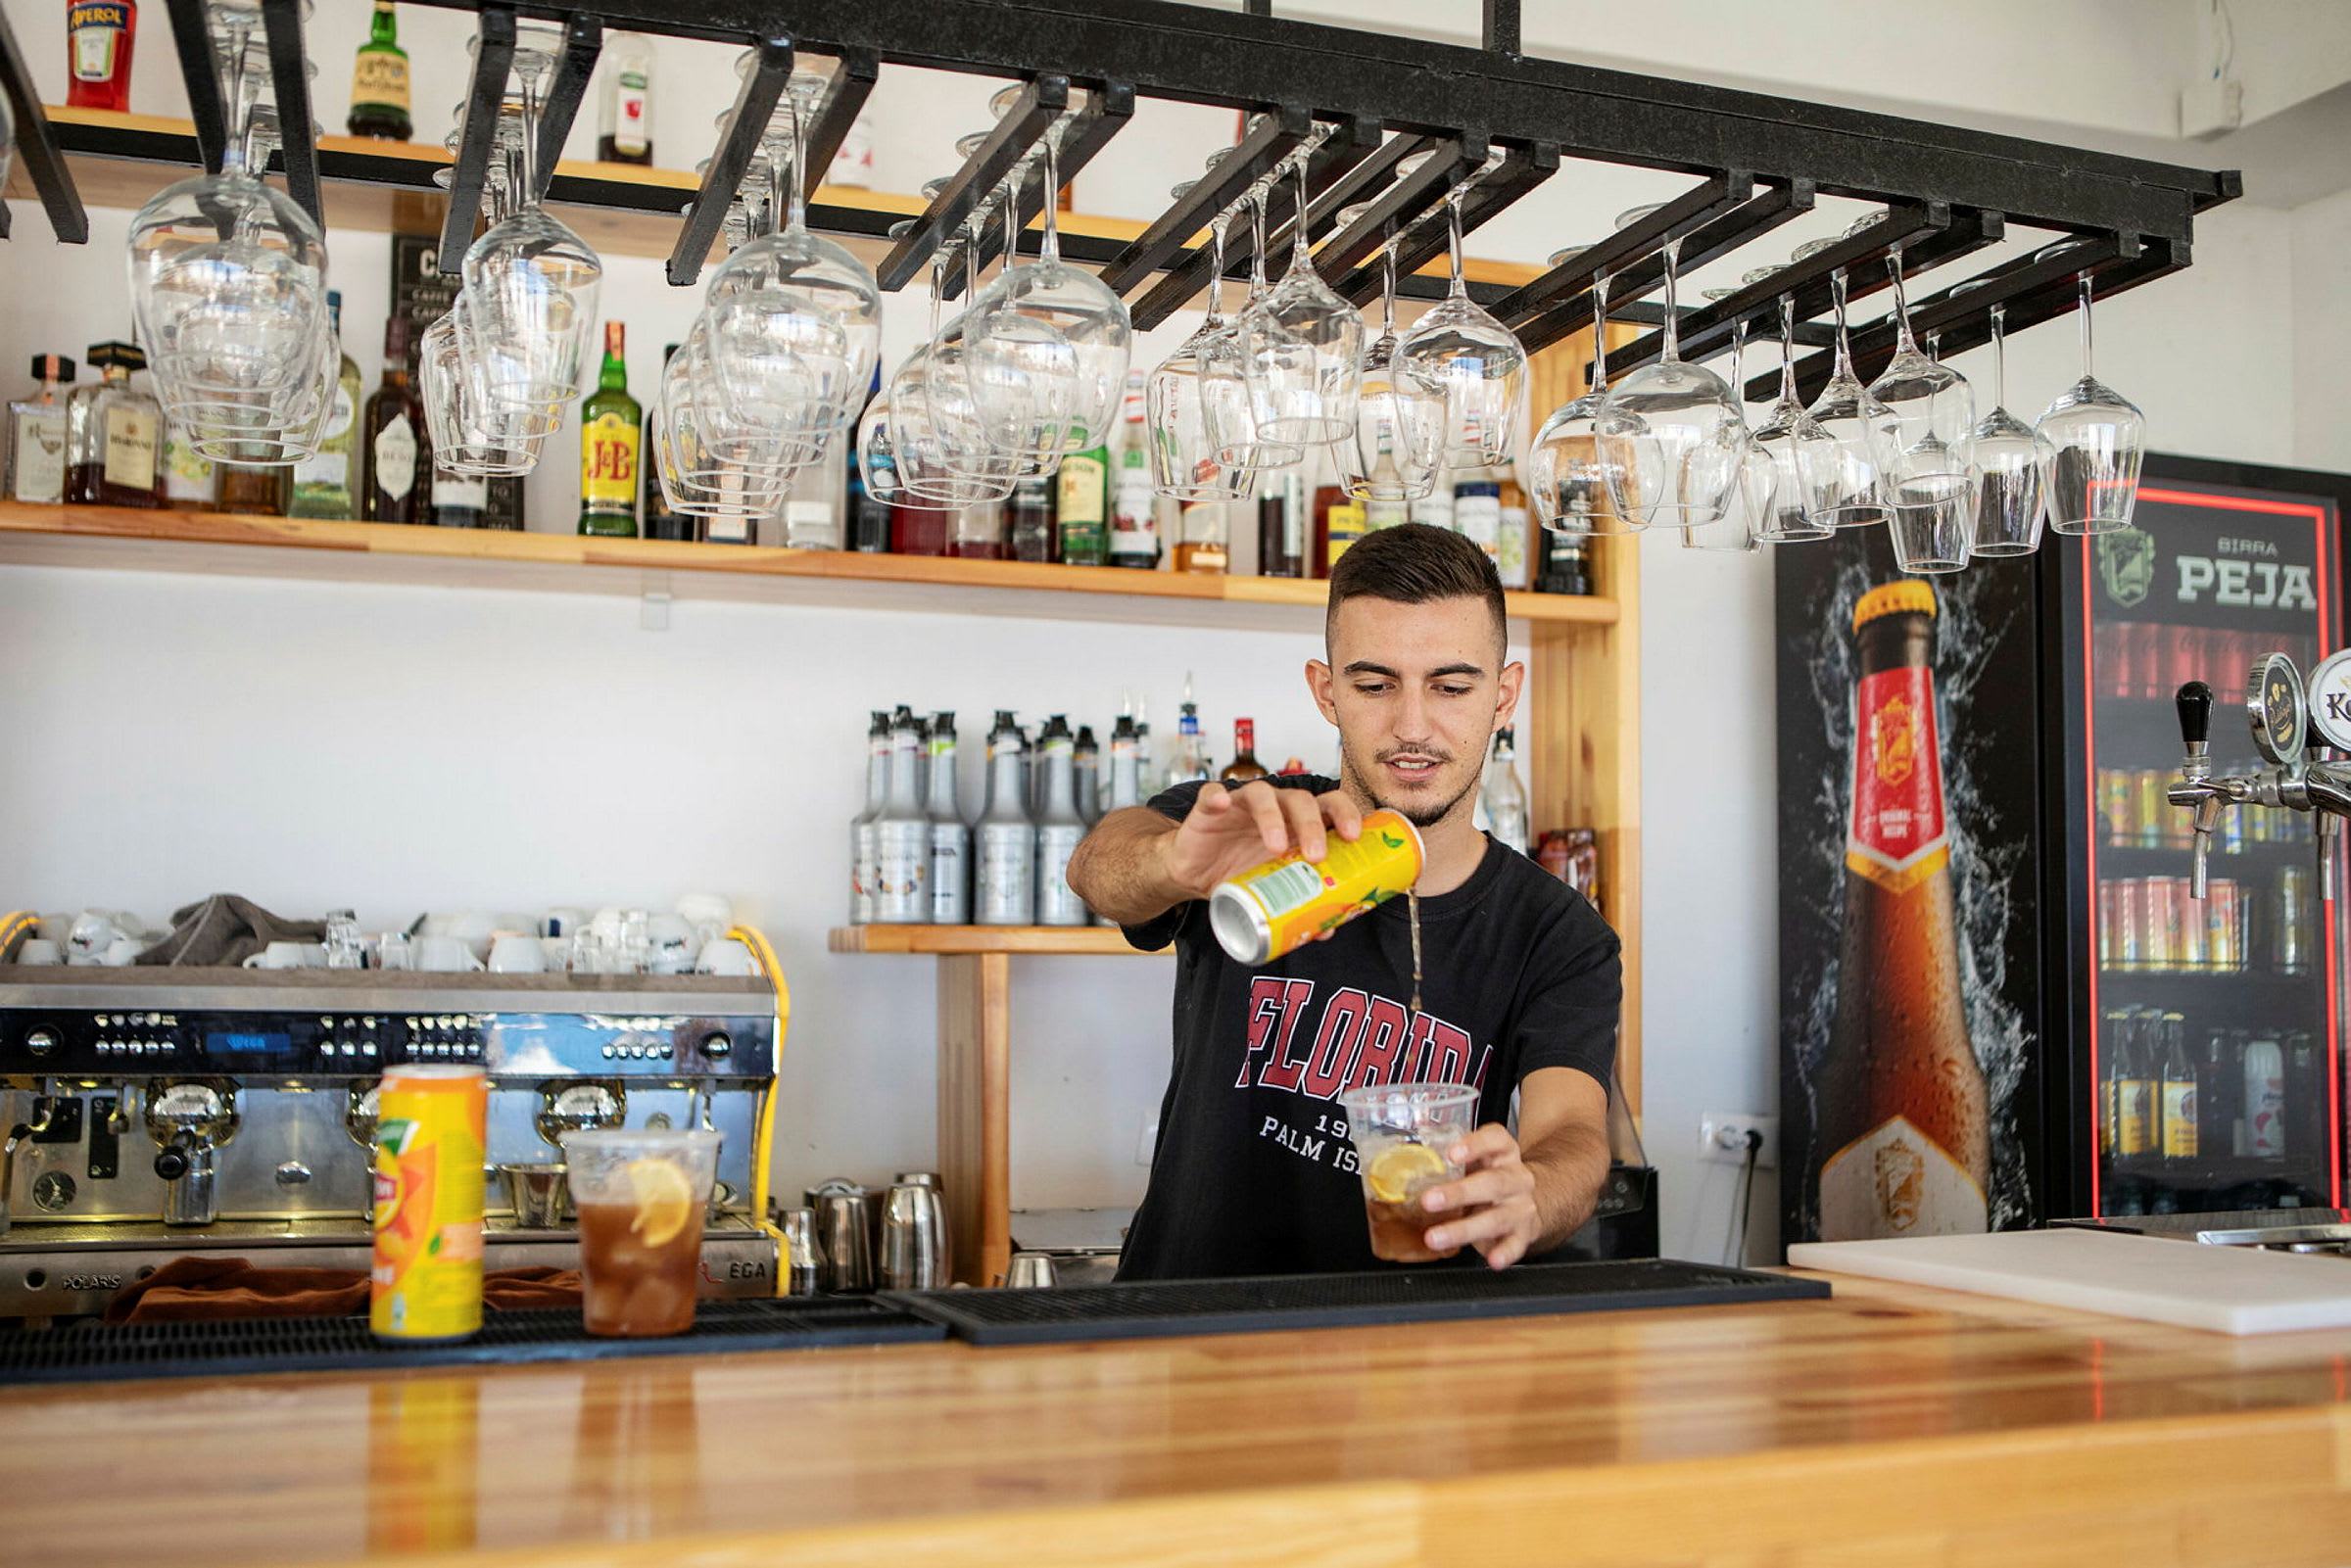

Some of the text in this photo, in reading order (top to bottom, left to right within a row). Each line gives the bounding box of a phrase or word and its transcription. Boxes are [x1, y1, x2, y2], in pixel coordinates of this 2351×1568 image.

[71, 8, 121, 29] APEROL
[587, 440, 631, 481] J&B
[2217, 537, 2279, 557] BIRRA
[2176, 555, 2318, 609] PEJA
[1260, 1116, 1325, 1162] PALM
[1315, 1115, 1353, 1142] 19
[63, 1274, 122, 1290] POLARIS
